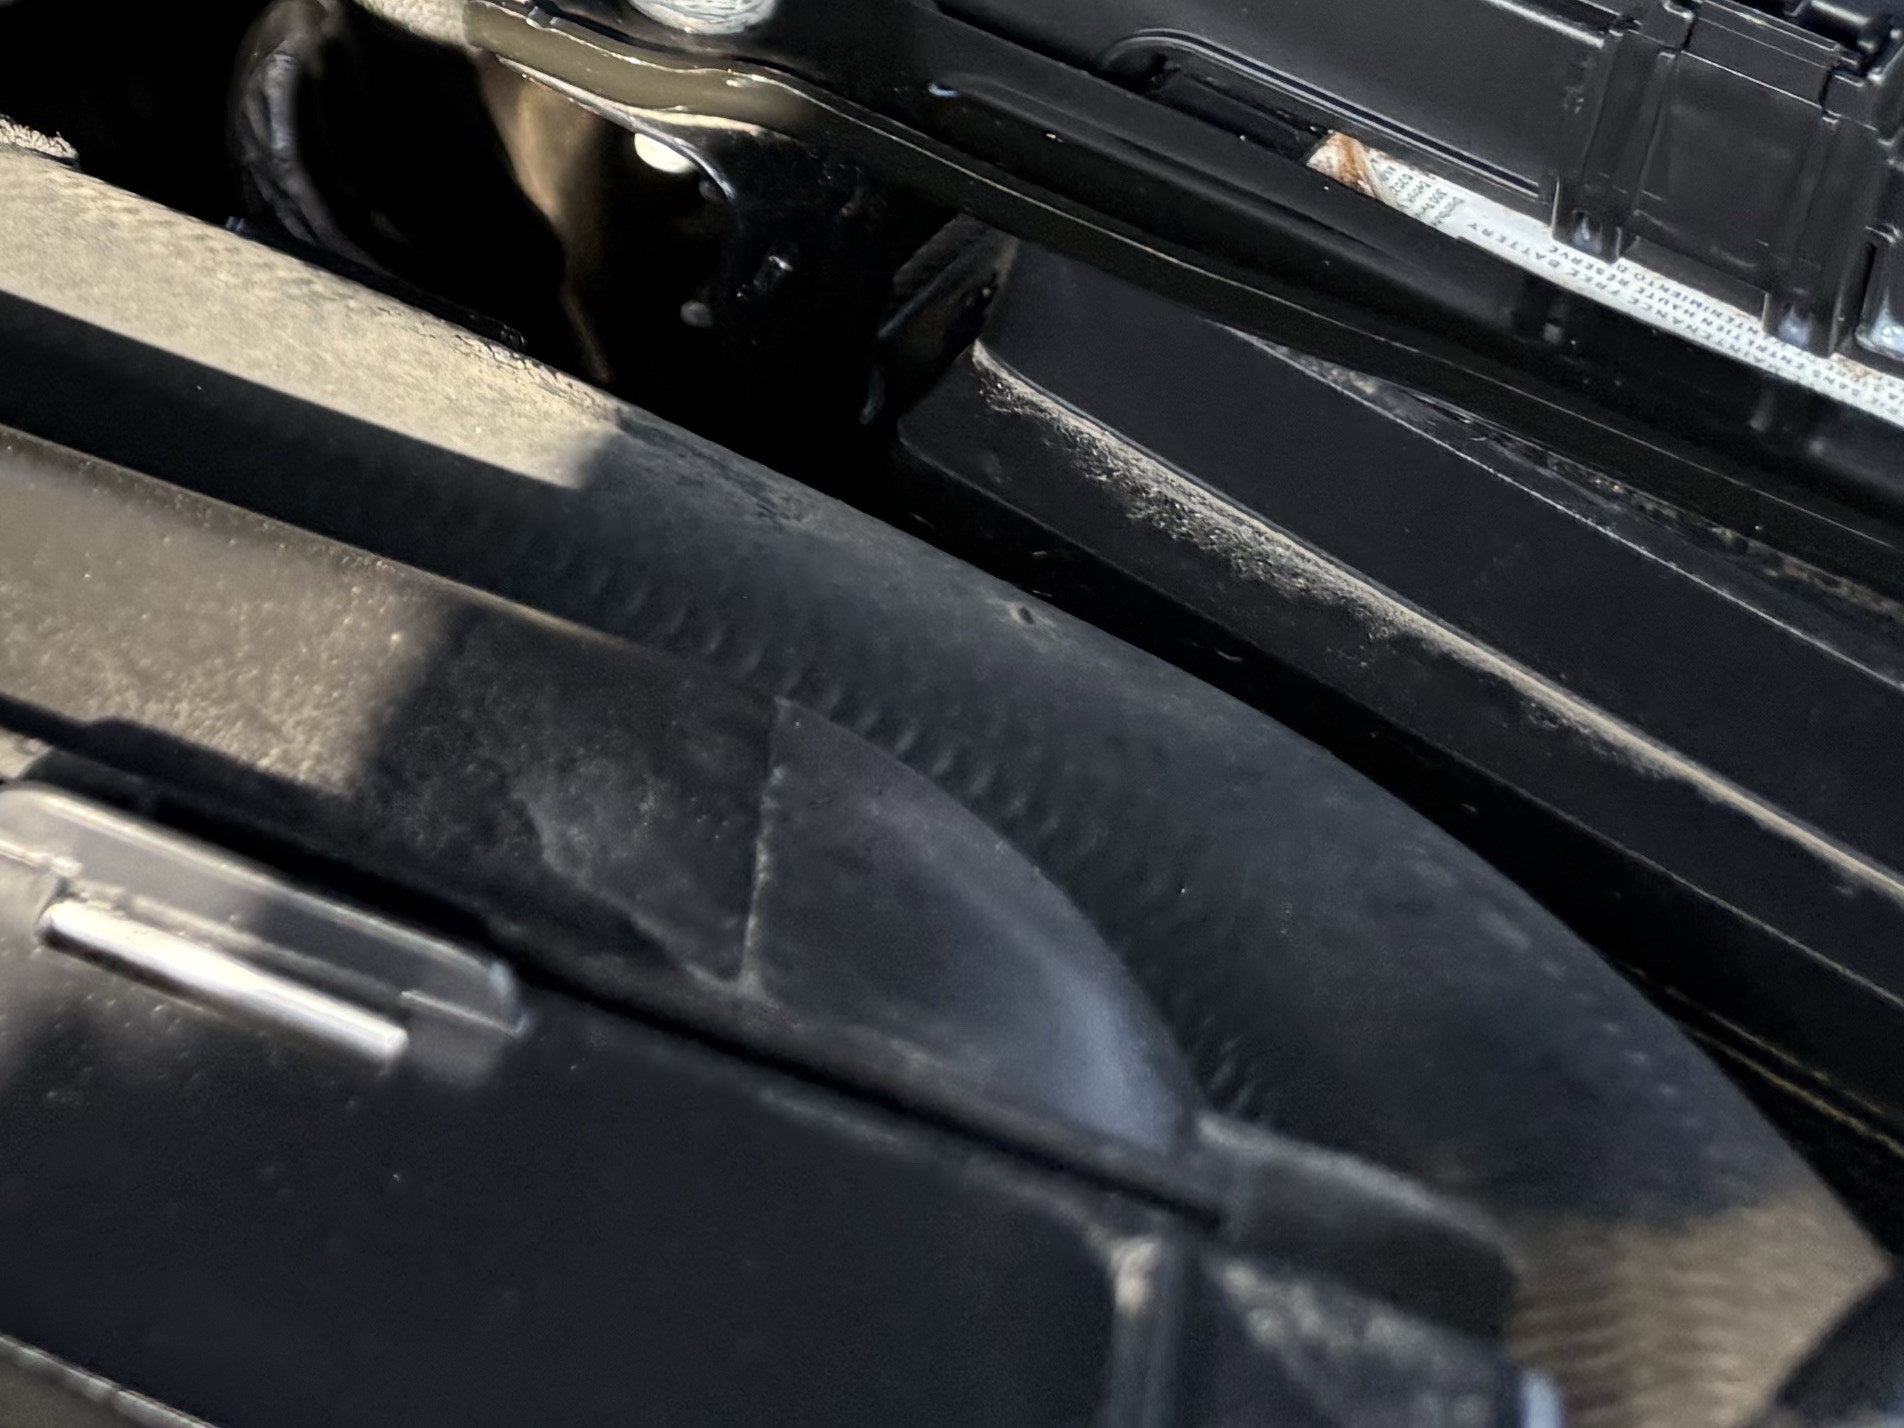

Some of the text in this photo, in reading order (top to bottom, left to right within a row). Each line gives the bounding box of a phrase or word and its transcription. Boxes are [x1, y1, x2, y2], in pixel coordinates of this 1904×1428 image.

[1467, 222, 1561, 268] BATTERY
[1566, 267, 1620, 296] FREE
[1635, 286, 1695, 317] HAUTE
